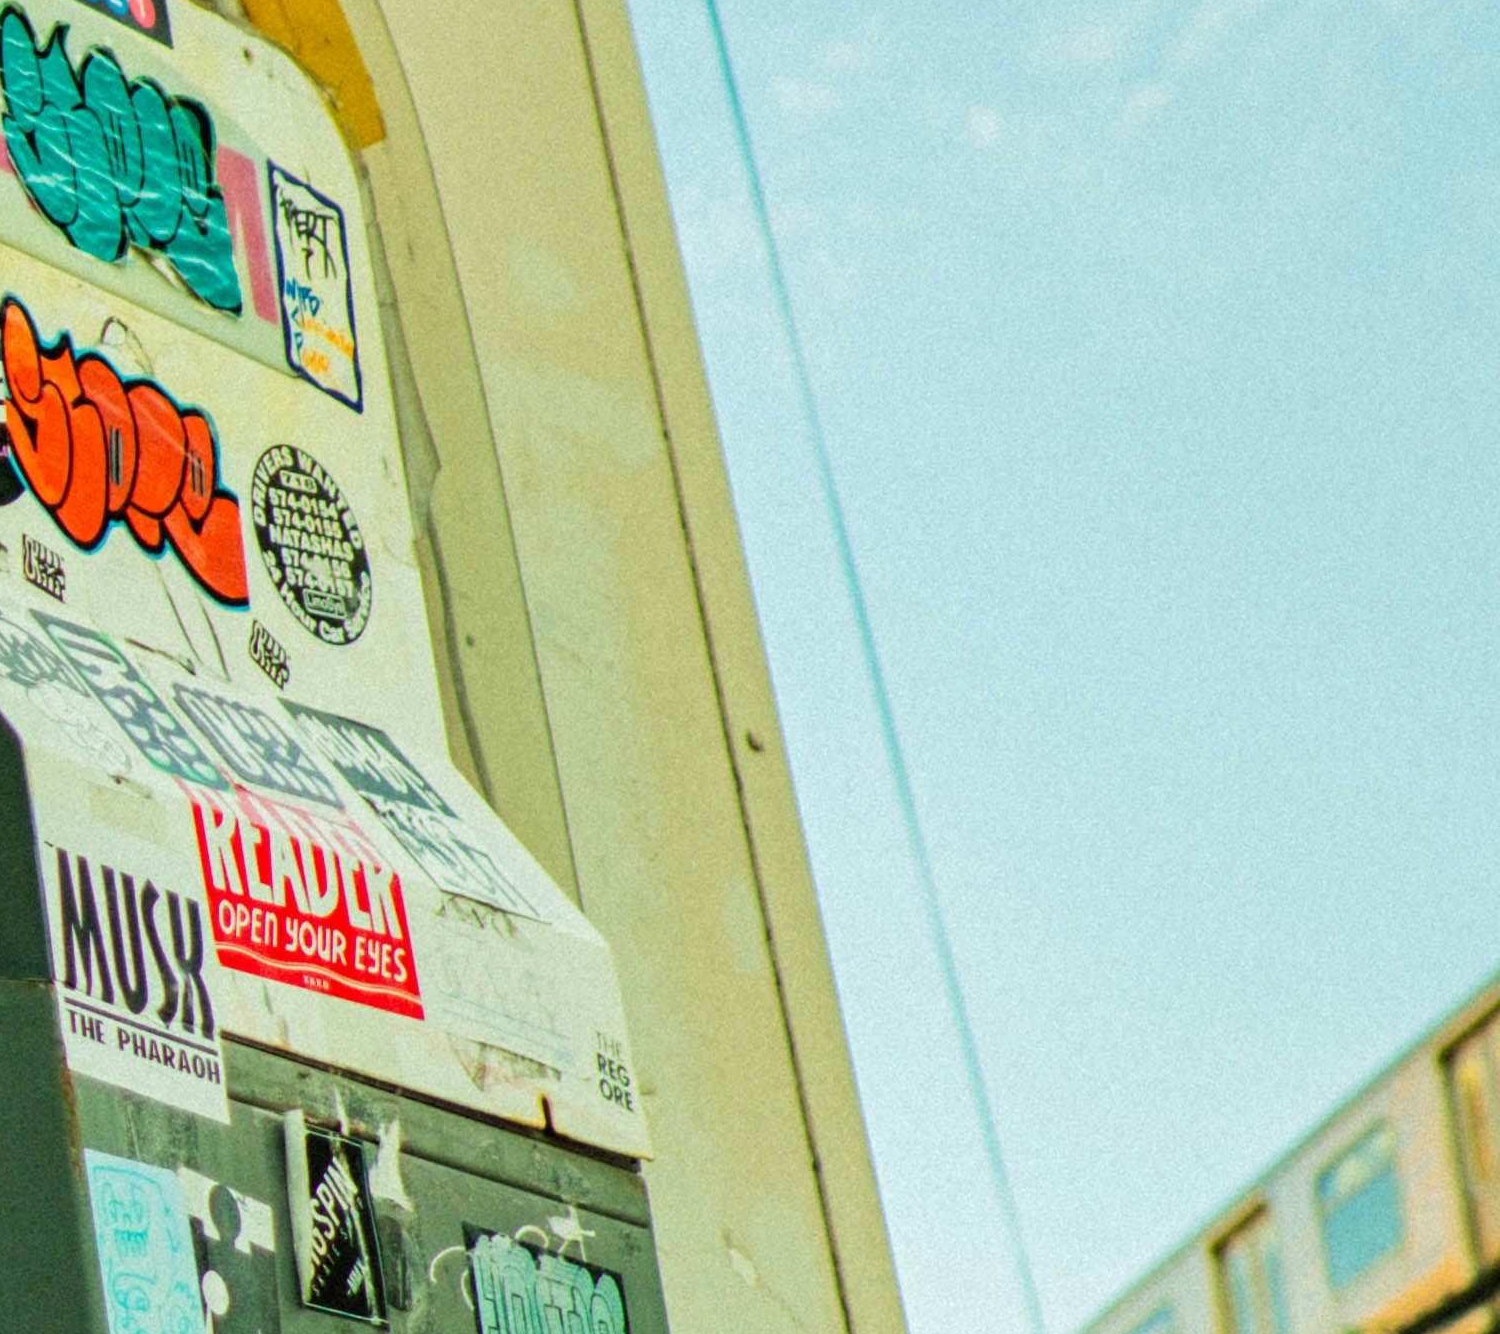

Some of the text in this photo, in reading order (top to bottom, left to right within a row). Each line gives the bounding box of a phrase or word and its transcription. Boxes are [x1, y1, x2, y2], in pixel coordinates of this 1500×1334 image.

[218, 898, 408, 983] OPEN YOUR EYES
[68, 1009, 221, 1085] THE PHARAOH
